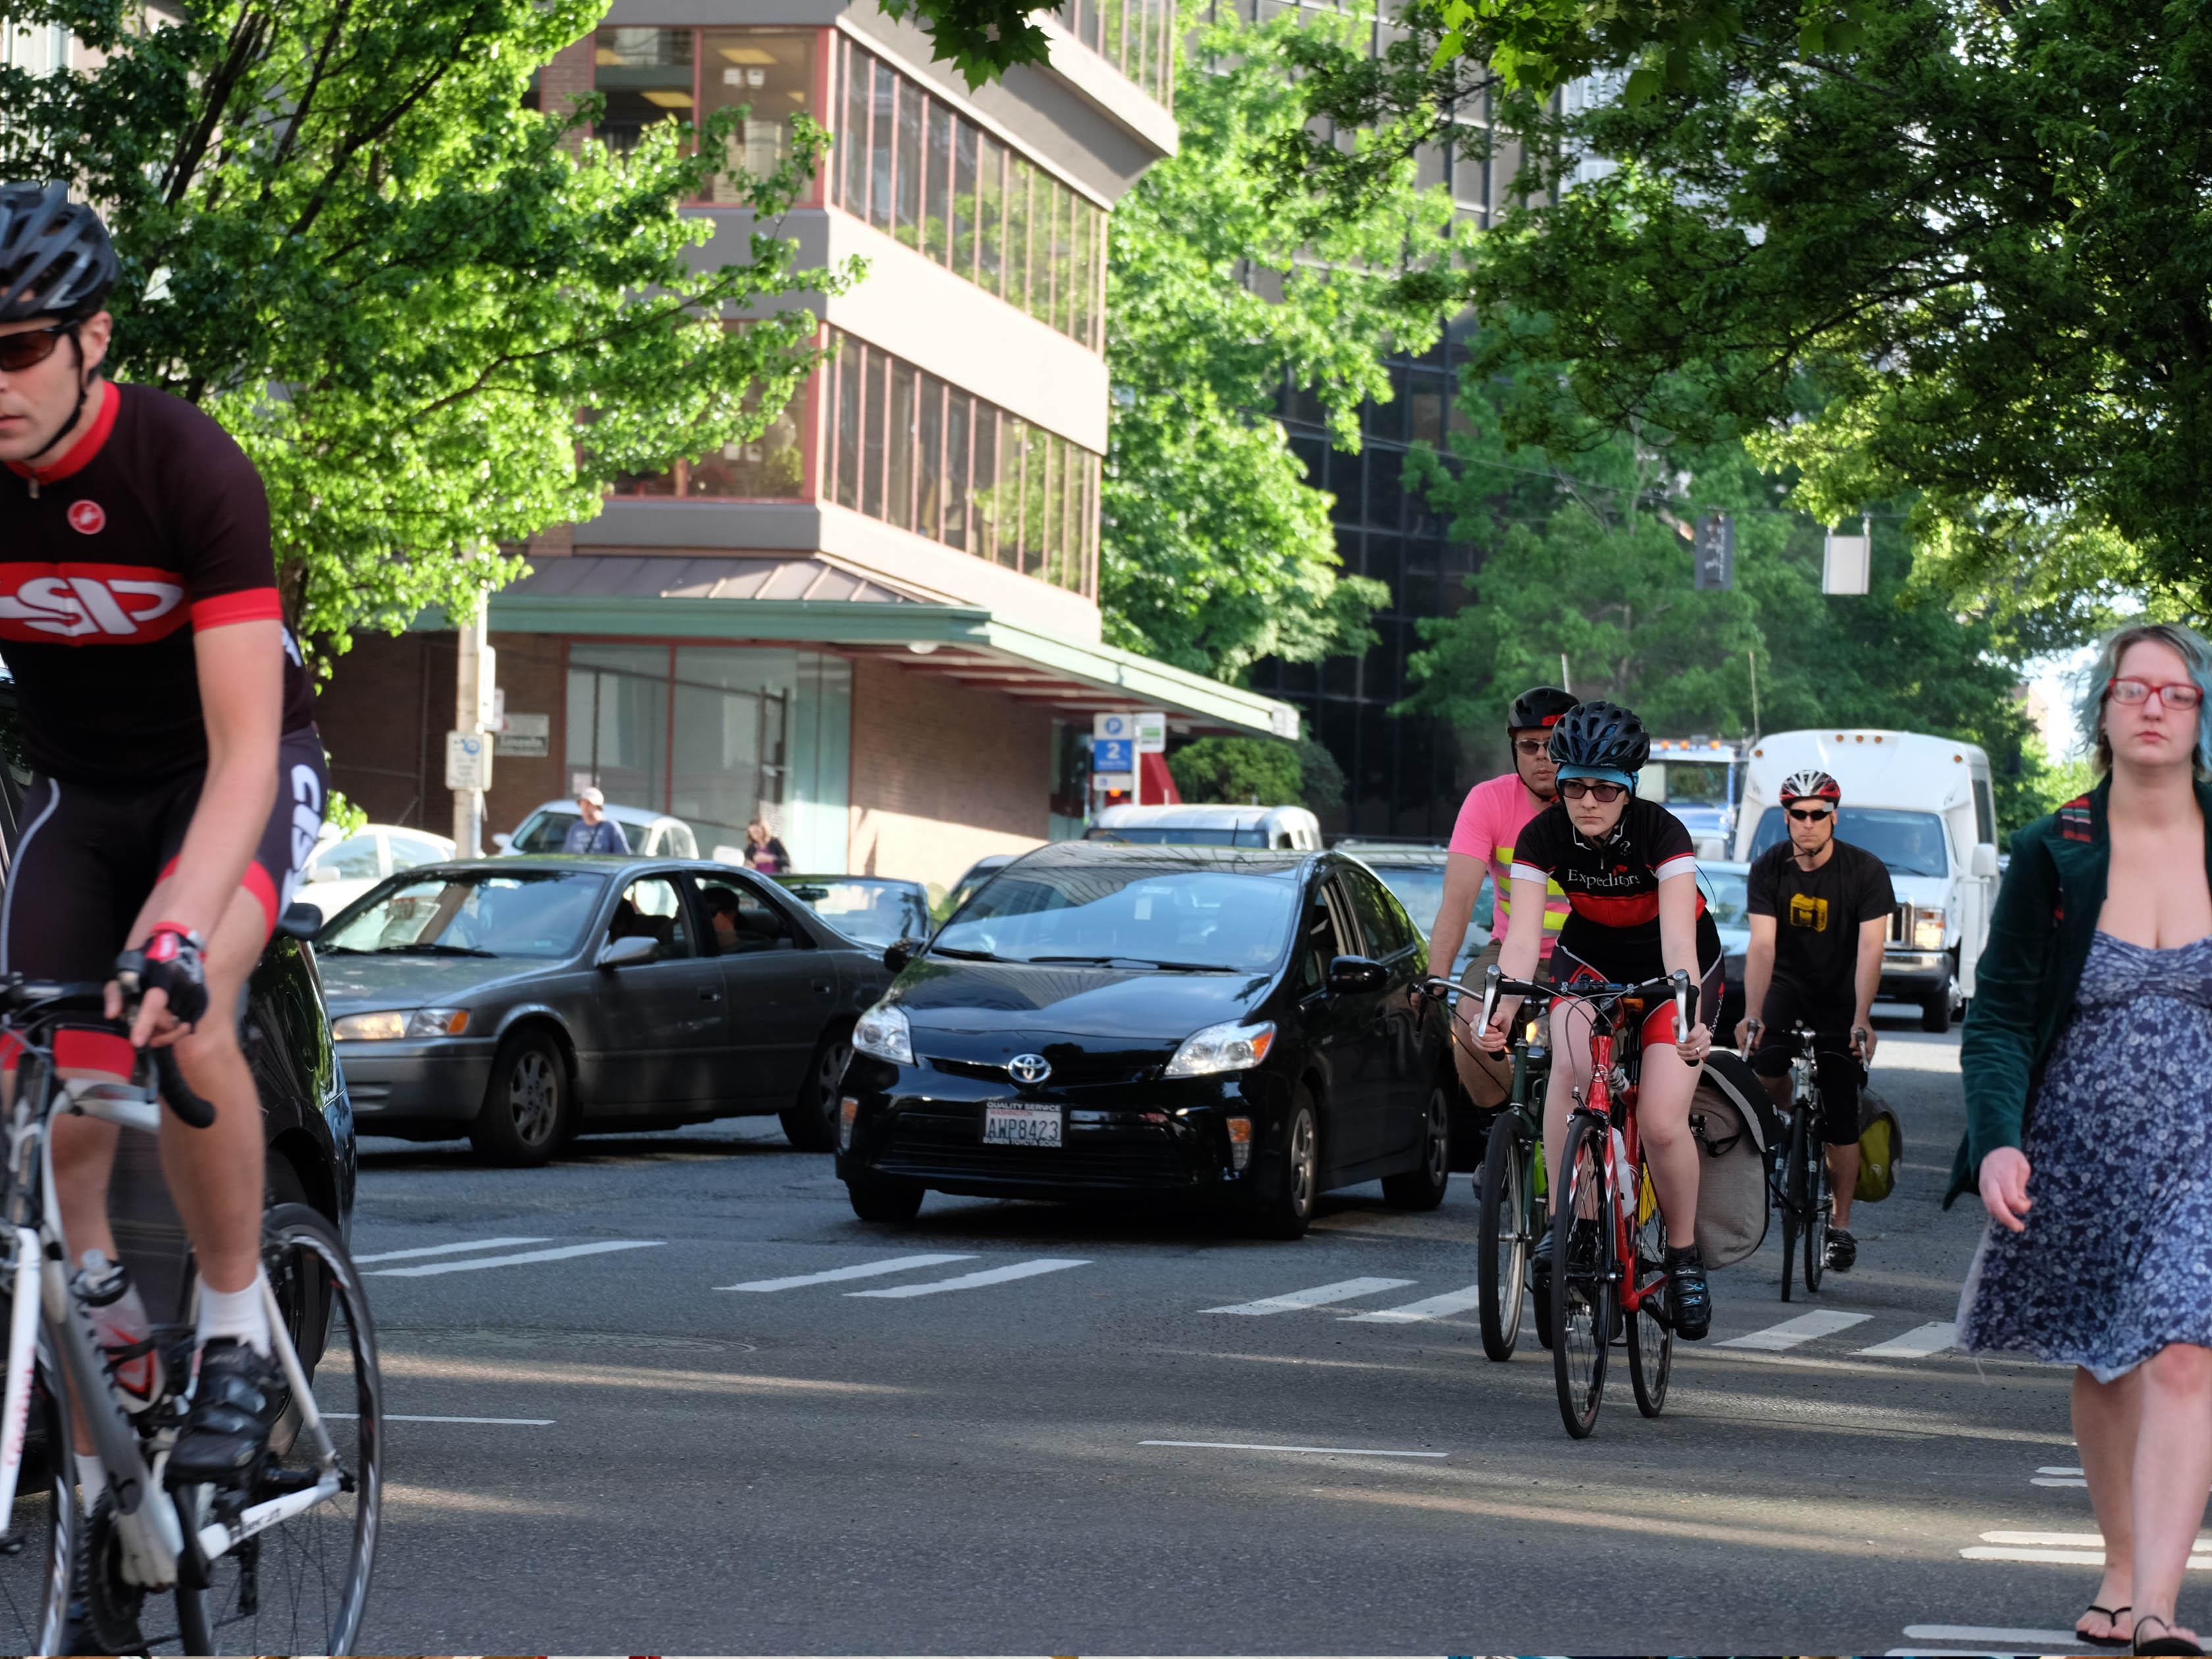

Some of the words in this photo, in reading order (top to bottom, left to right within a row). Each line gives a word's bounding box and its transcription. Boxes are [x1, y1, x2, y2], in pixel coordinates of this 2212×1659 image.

[1107, 742, 1120, 759] 2
[1567, 868, 1641, 889] Expeditors
[986, 1101, 1022, 1110] QUALITY
[988, 1117, 1059, 1140] AWP8423
